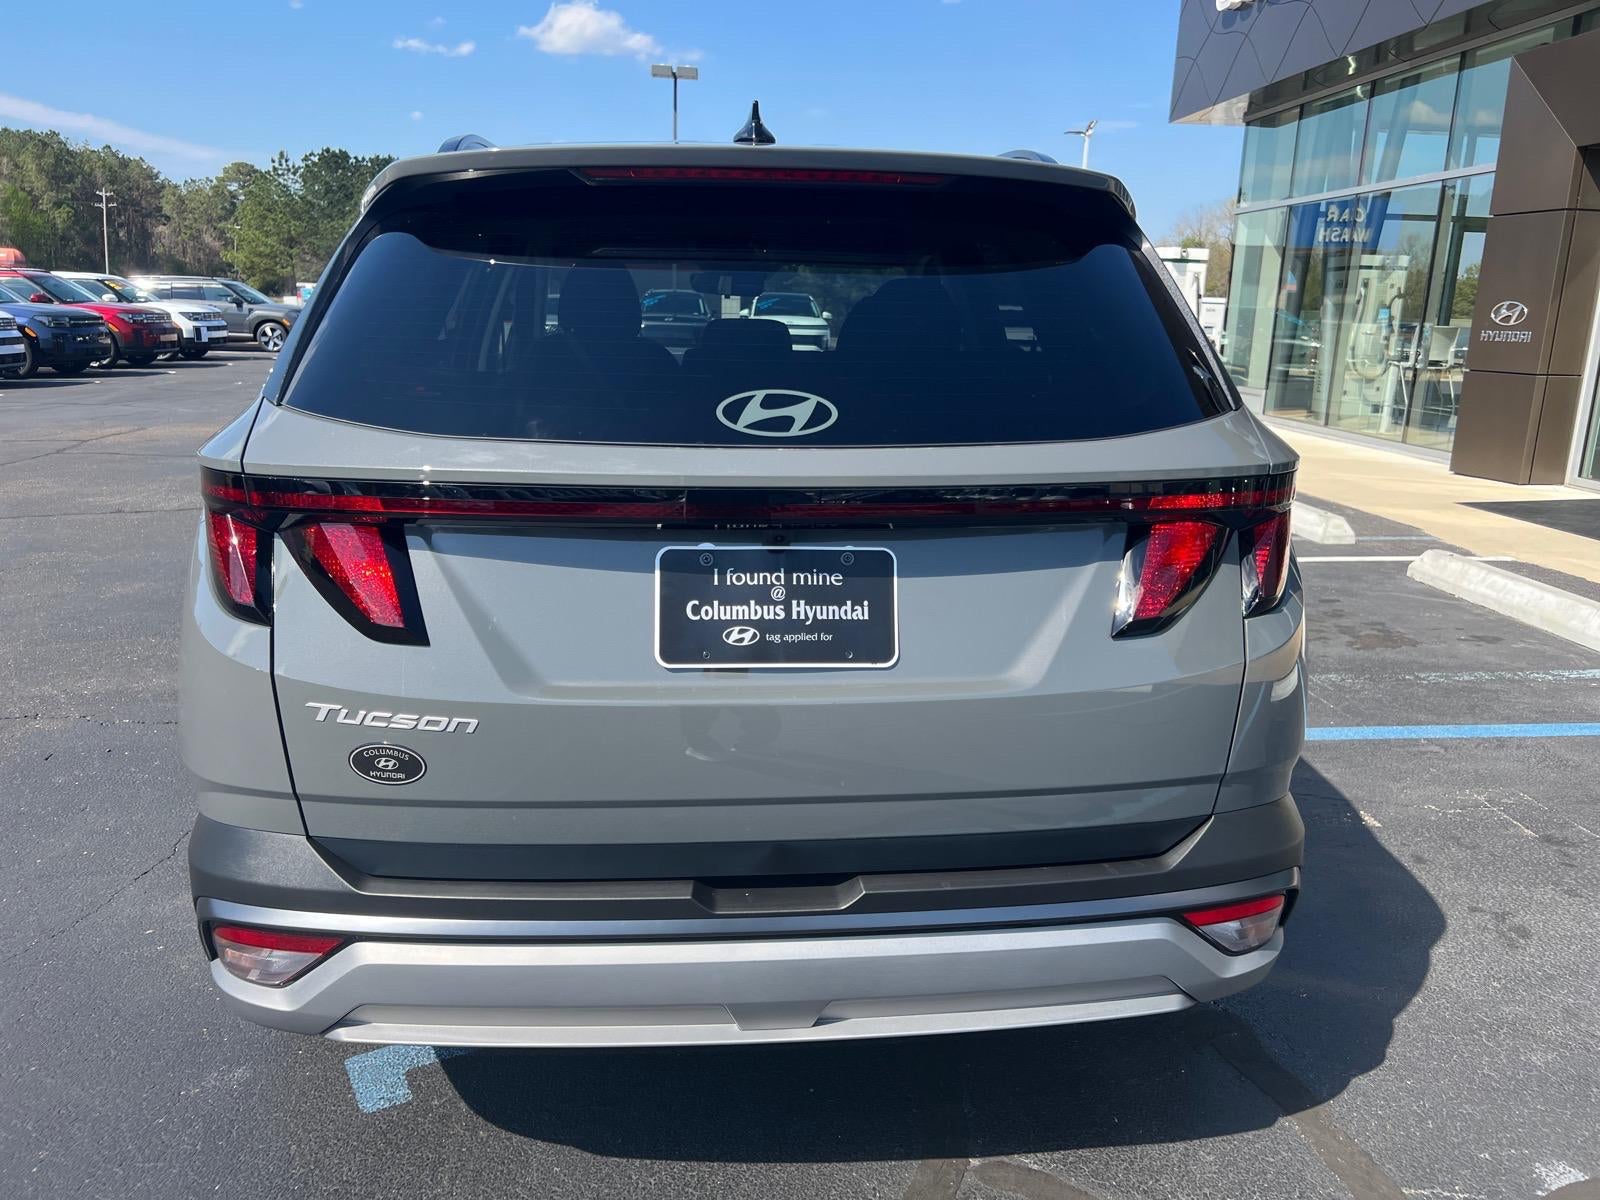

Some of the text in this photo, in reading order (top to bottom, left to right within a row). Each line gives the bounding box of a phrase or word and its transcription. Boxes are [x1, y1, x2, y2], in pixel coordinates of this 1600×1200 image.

[1480, 330, 1532, 343] HYUNDAI
[713, 568, 844, 586] I found mine
[770, 586, 786, 601] @
[686, 600, 869, 625] Columbus Hyundai
[765, 631, 833, 644] tag applied for
[363, 749, 410, 761] COLUMBUS
[369, 770, 406, 780] HYUNDAI
